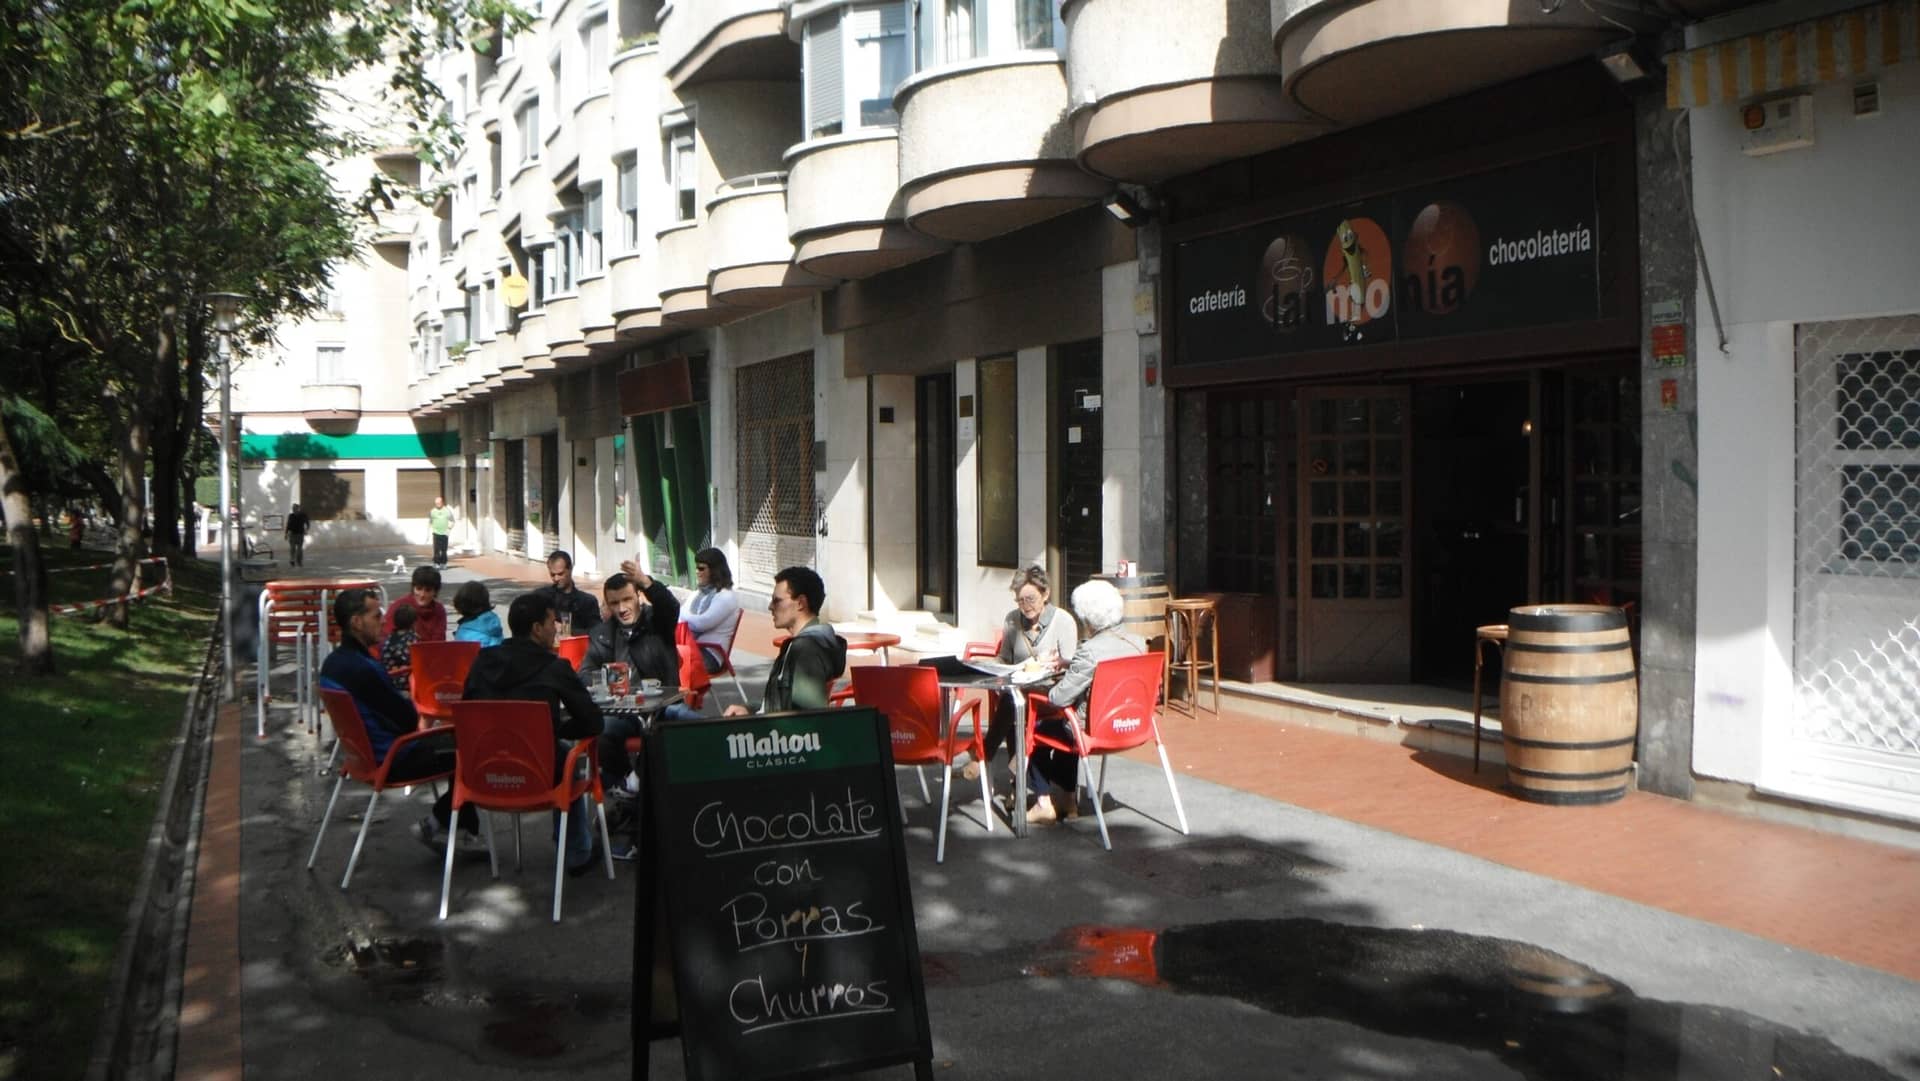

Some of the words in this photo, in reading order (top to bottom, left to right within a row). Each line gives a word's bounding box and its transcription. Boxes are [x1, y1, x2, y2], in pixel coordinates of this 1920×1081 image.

[1489, 221, 1591, 266] chocolatería
[1189, 284, 1246, 315] cafetería
[726, 729, 822, 760] Mahou
[692, 787, 882, 851] Chocolate
[753, 858, 824, 886] con
[720, 892, 873, 946] Porras
[729, 975, 889, 1024] Churros
